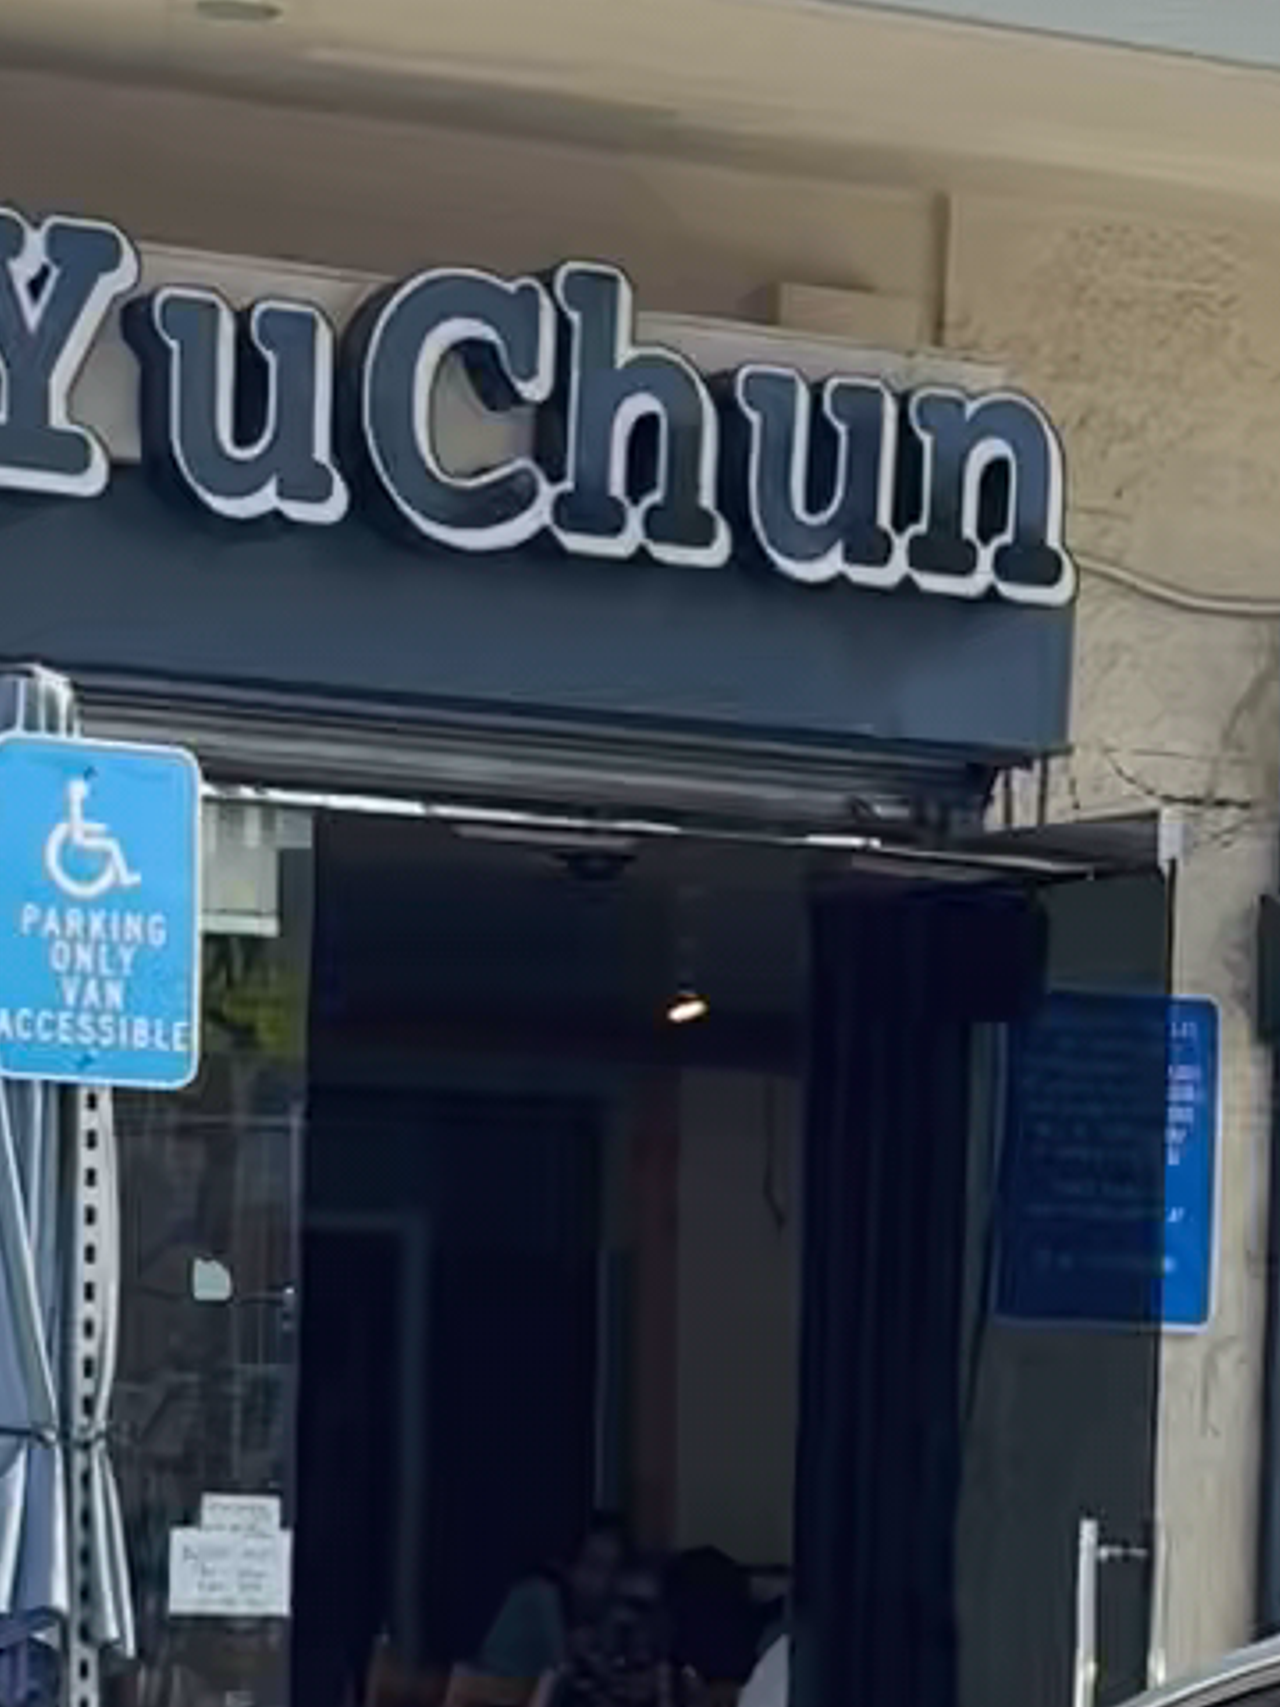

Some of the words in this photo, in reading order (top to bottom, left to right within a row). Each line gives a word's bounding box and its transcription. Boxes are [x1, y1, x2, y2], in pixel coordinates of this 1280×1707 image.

[21, 903, 167, 947] PARKING
[51, 940, 136, 976] ONLY
[61, 975, 125, 1011] VAN
